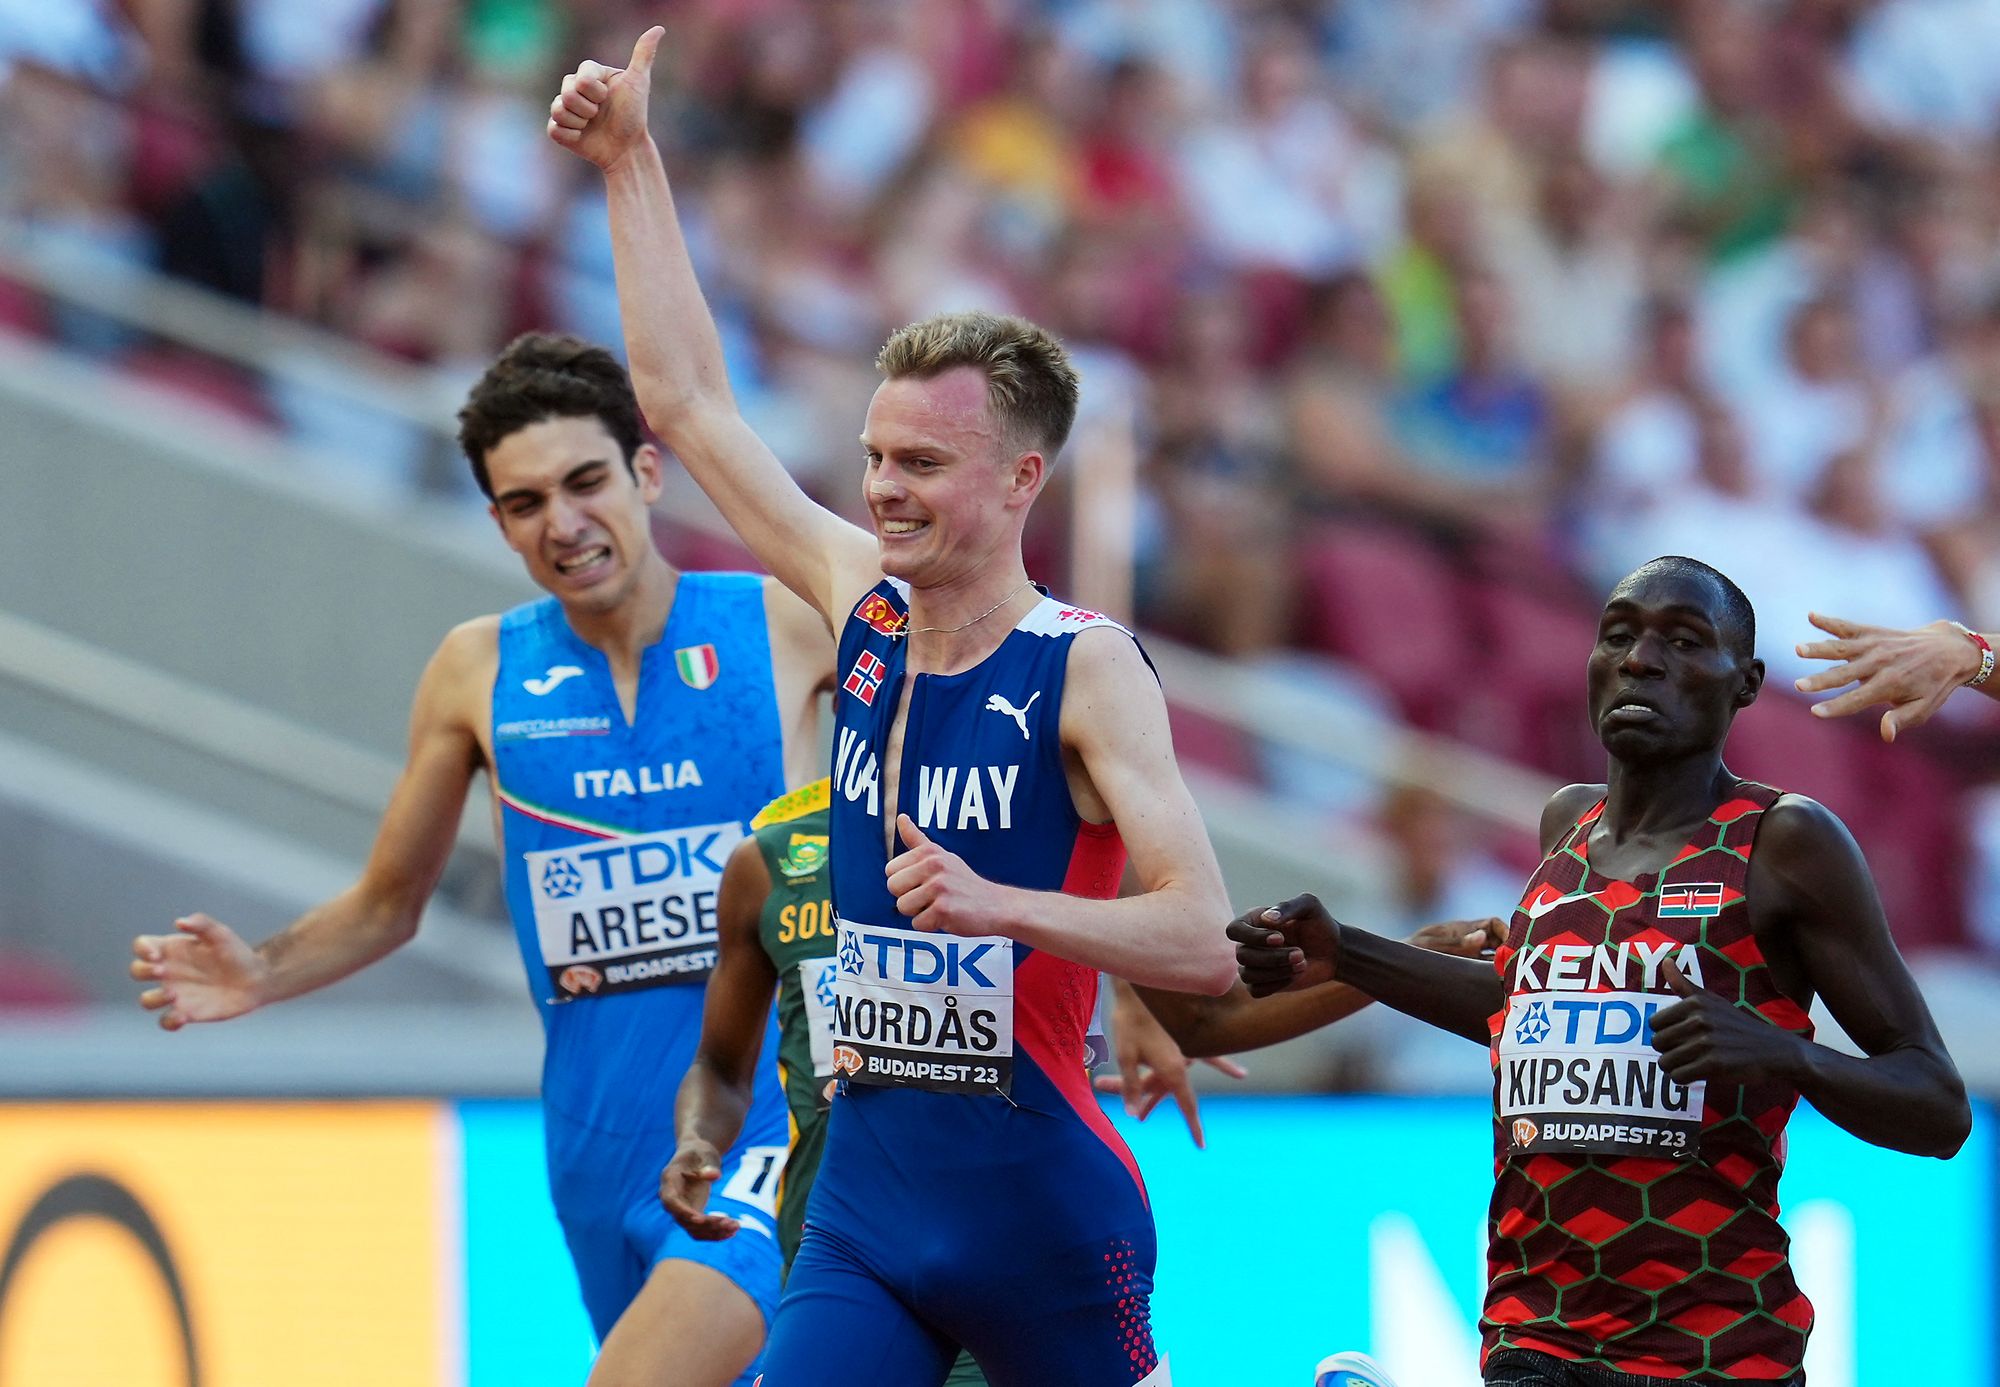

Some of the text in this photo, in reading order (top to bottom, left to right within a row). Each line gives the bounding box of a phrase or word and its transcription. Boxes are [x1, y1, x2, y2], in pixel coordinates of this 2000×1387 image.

[573, 760, 703, 799] ITALIA
[580, 832, 723, 891] TDK
[570, 890, 718, 956] ARESE
[605, 949, 718, 984] BUDAPEST
[863, 934, 997, 988] TDK
[1514, 941, 1704, 992] KENYA
[833, 993, 998, 1051] NORDÅS
[868, 1056, 998, 1084] BUDAPEST 23
[1508, 1058, 1688, 1112] KIPSANG
[1542, 1123, 1686, 1147] BUDAPEST 23
